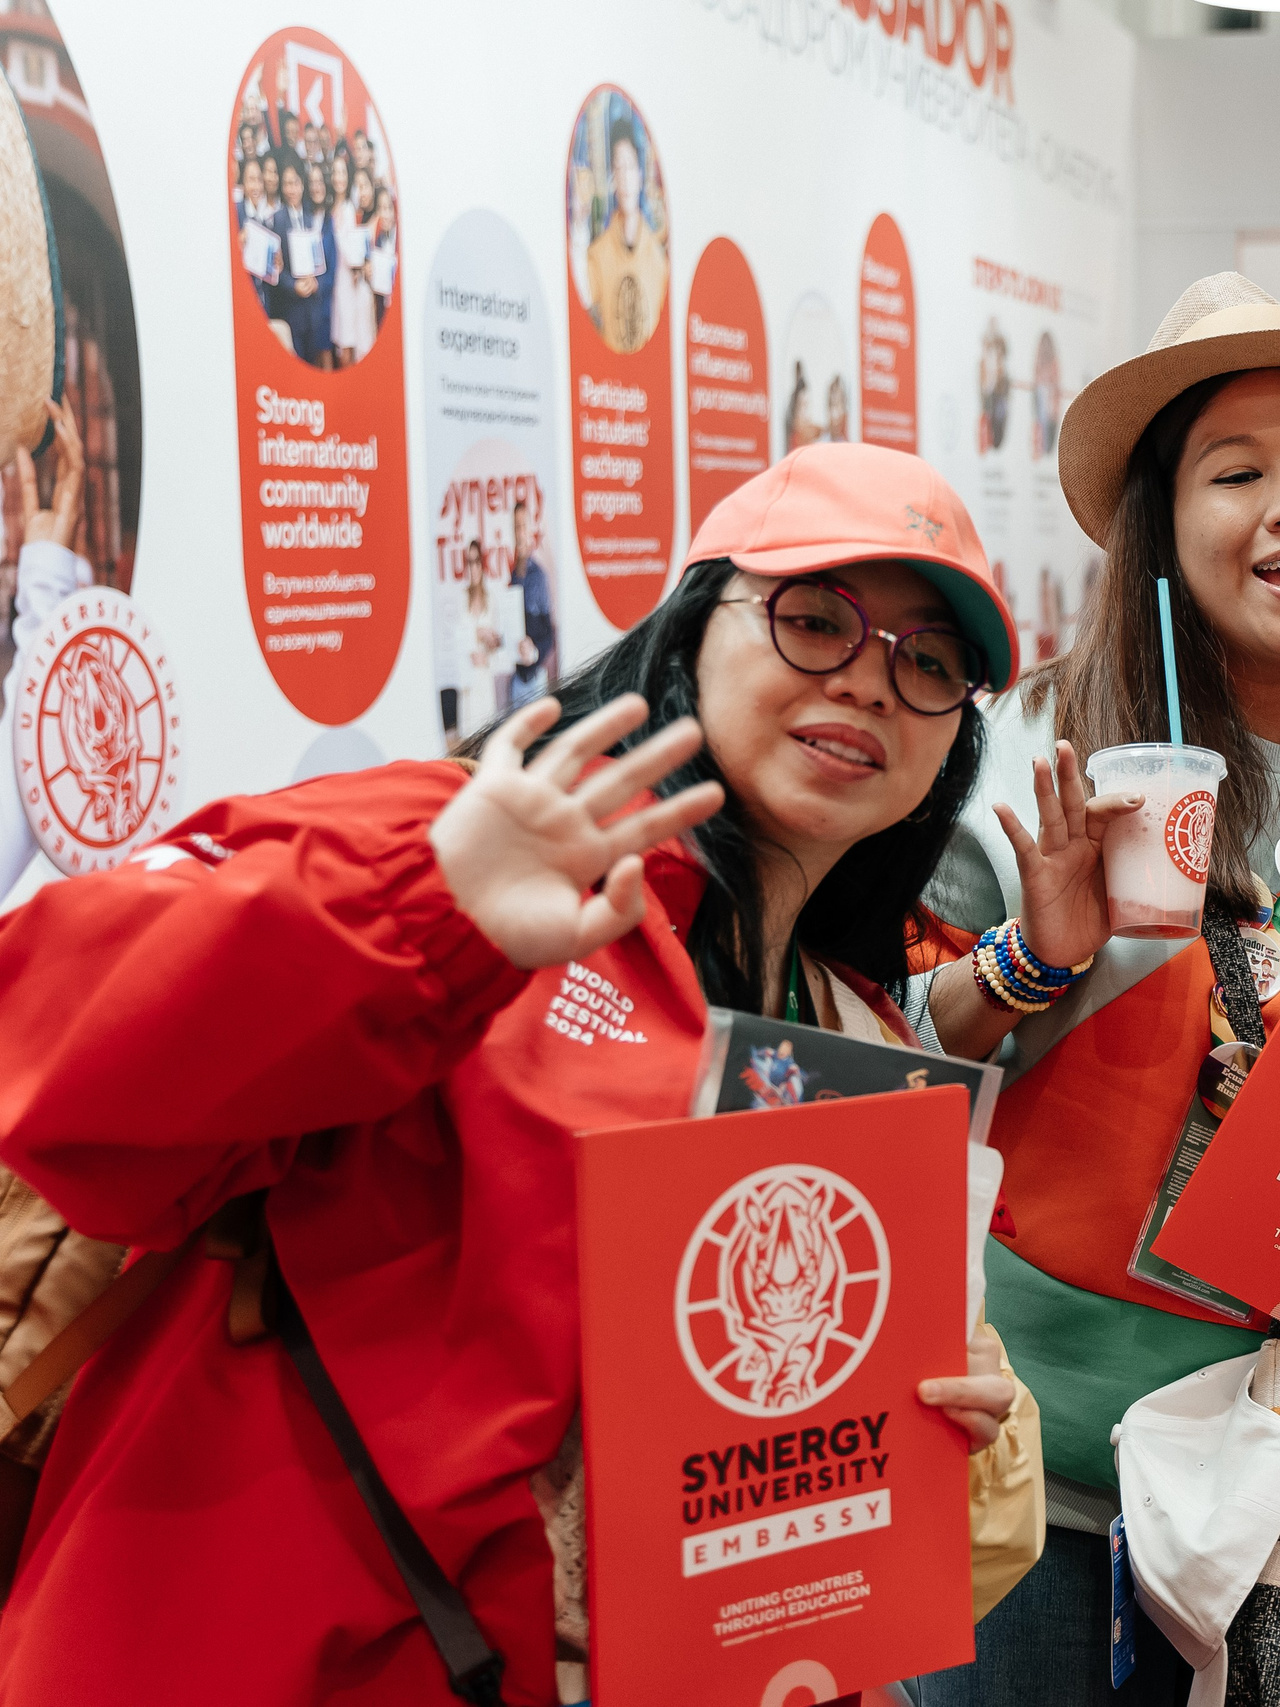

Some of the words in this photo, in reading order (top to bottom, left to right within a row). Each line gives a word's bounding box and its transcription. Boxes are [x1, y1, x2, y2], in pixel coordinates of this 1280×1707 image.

[256, 385, 325, 436] Strong
[257, 428, 378, 470] international
[259, 473, 369, 517] community
[260, 511, 362, 549] worldwide
[21, 601, 150, 730] UNIVERSITY
[149, 655, 180, 836] EMBASSY
[1176, 793, 1216, 811] UNIVERS
[1168, 815, 1192, 875] SYNERGY
[560, 978, 627, 1027] YOUTH
[567, 960, 635, 1013] WORLD
[544, 1011, 594, 1046] 2024
[550, 995, 648, 1043] FESTIVAL
[1216, 1083, 1238, 1099] Rusi
[1221, 1067, 1246, 1085] Ecua
[1224, 1077, 1242, 1092] has
[1230, 1063, 1249, 1078] Des
[682, 1412, 889, 1493] SYNERGY
[683, 1453, 889, 1524] UNIVERSITY
[694, 1501, 880, 1564] EMBASSY
[713, 1606, 786, 1636] THROUGH
[787, 1584, 870, 1616] EDUCATION
[720, 1591, 781, 1619] UNITING
[783, 1570, 864, 1601] COUNTRIES
